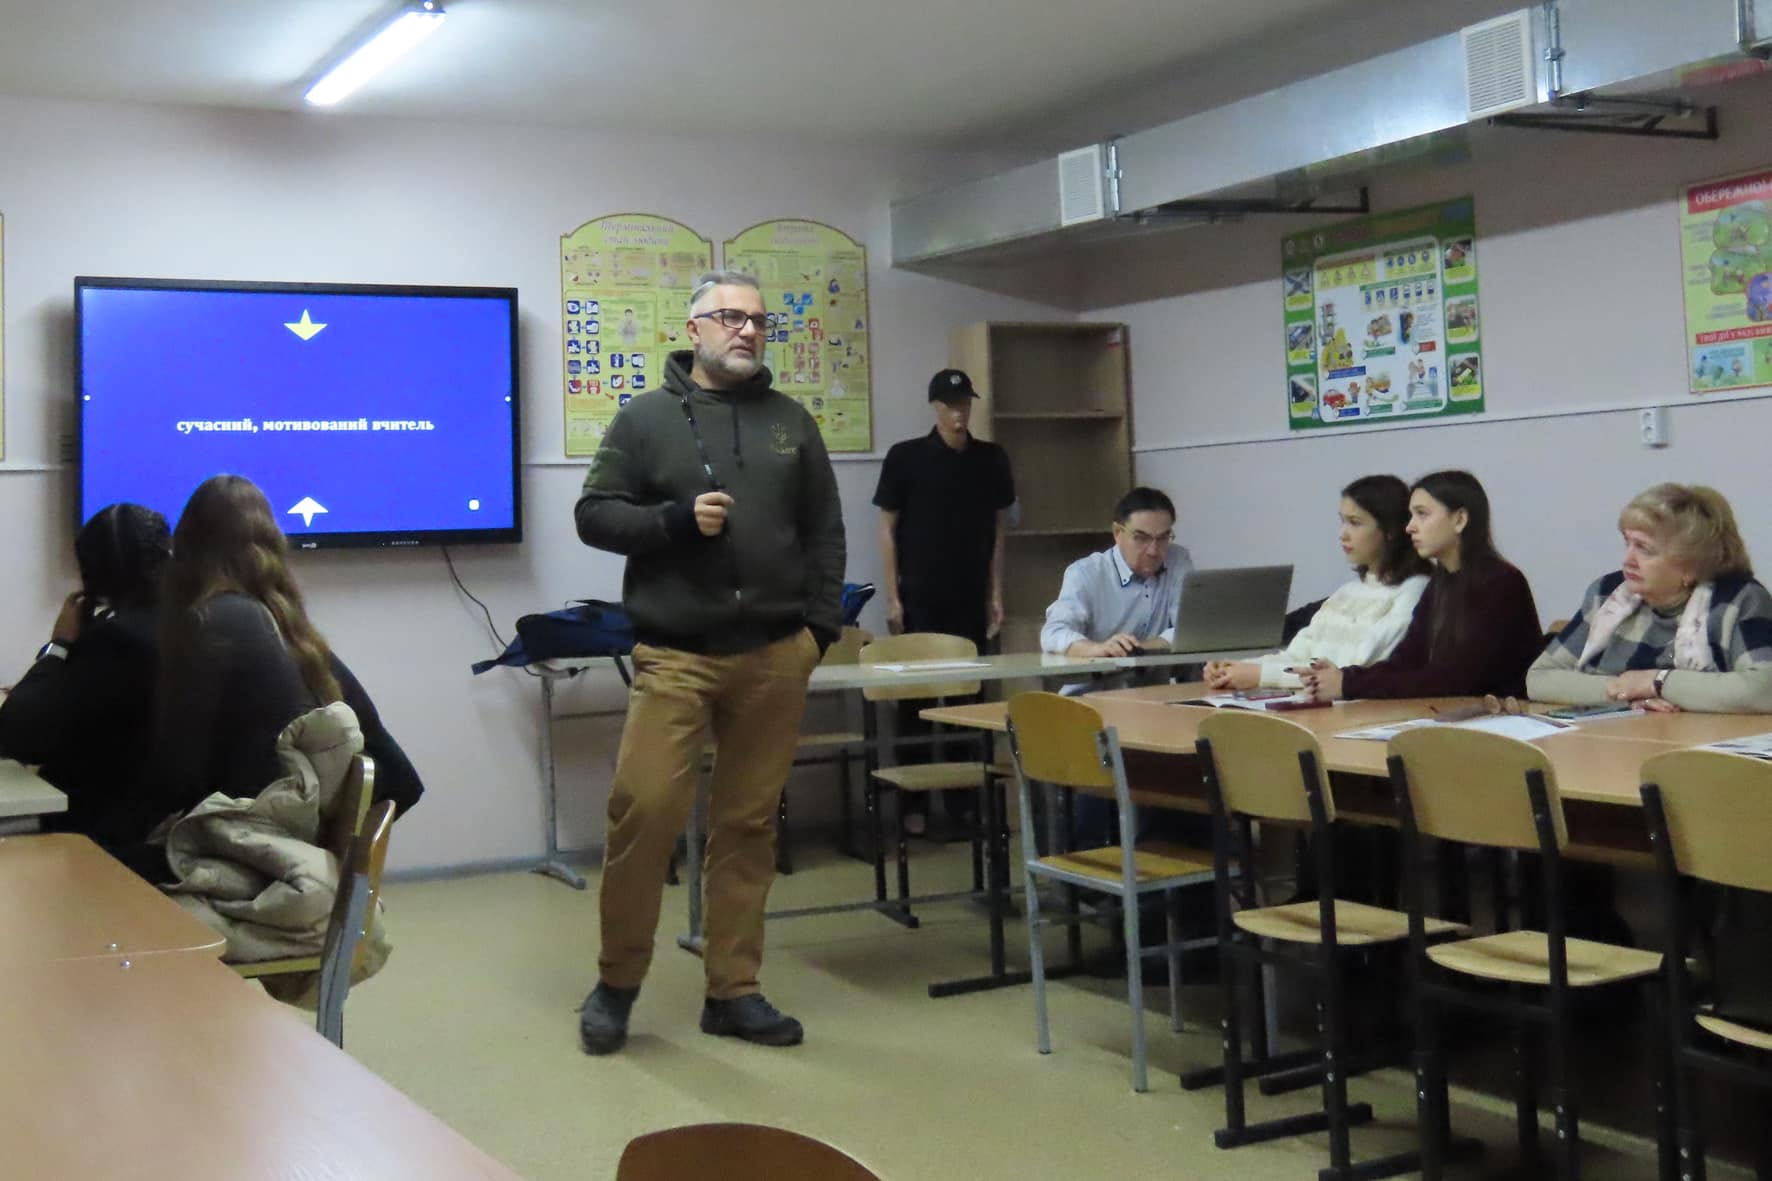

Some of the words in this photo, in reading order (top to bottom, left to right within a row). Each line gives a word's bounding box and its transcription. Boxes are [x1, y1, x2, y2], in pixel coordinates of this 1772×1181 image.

[176, 417, 258, 435] сучасний,
[262, 417, 368, 432] мотивований
[371, 420, 435, 431] вчитель
